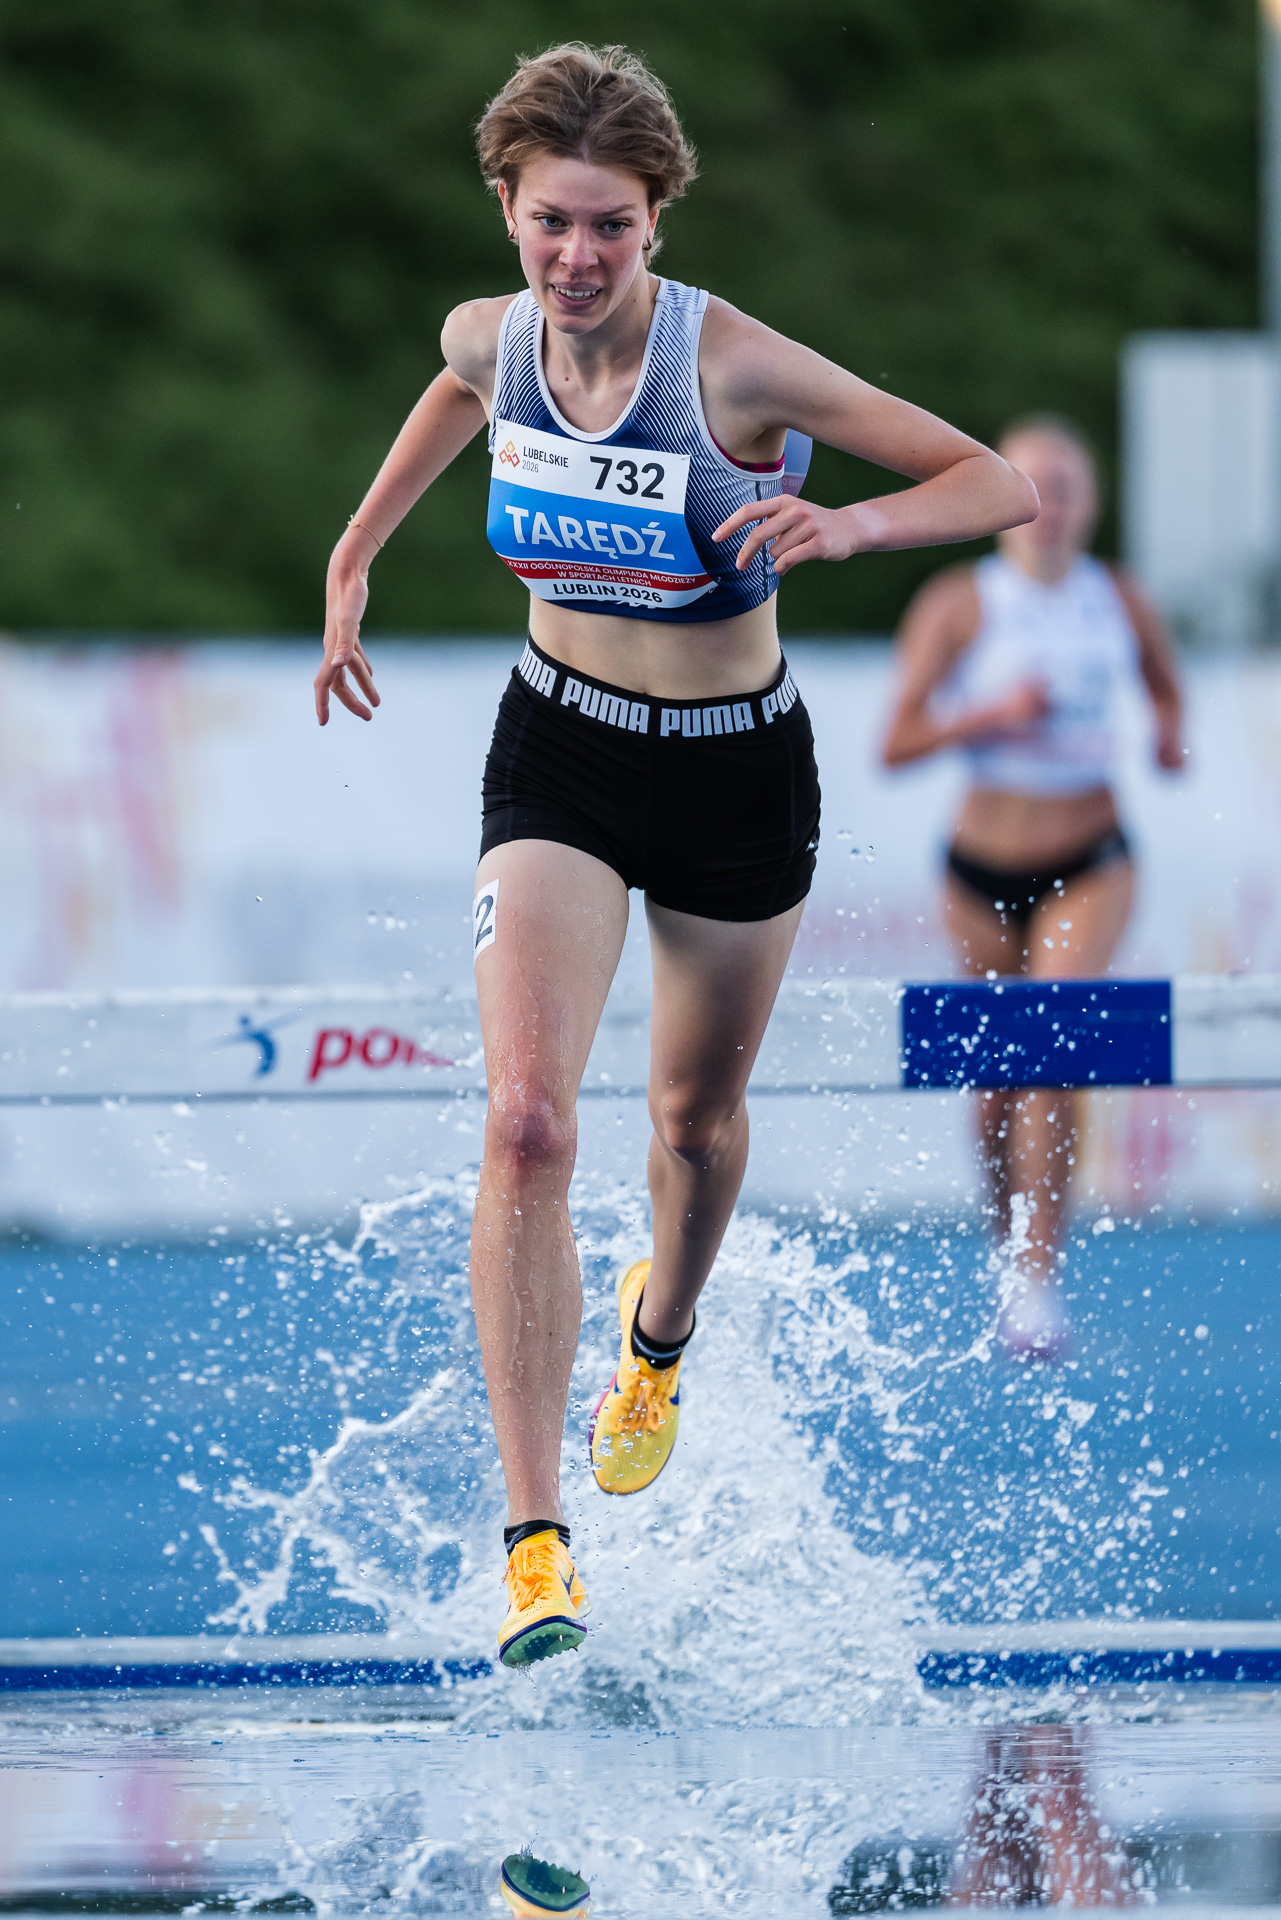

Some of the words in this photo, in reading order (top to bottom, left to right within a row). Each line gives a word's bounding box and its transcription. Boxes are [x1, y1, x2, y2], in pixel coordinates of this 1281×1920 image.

[522, 460, 539, 473] 2026
[523, 446, 569, 468] LUBELSKIE
[590, 455, 665, 500] 732
[505, 504, 675, 560] TARĘDŹ
[507, 560, 529, 569] XXXII
[530, 562, 601, 574] OGÓLNOPOLSKA
[602, 567, 649, 579] OLIMPIADA
[568, 571, 616, 582] SPORTACH
[616, 576, 652, 587] LETNICH
[553, 583, 617, 596] LUBLIN
[619, 586, 663, 603] 2026
[518, 639, 557, 698] UMA
[561, 676, 650, 734] PUMA
[660, 702, 755, 737] PUMA
[761, 667, 799, 725] PUM
[475, 895, 494, 949] 2
